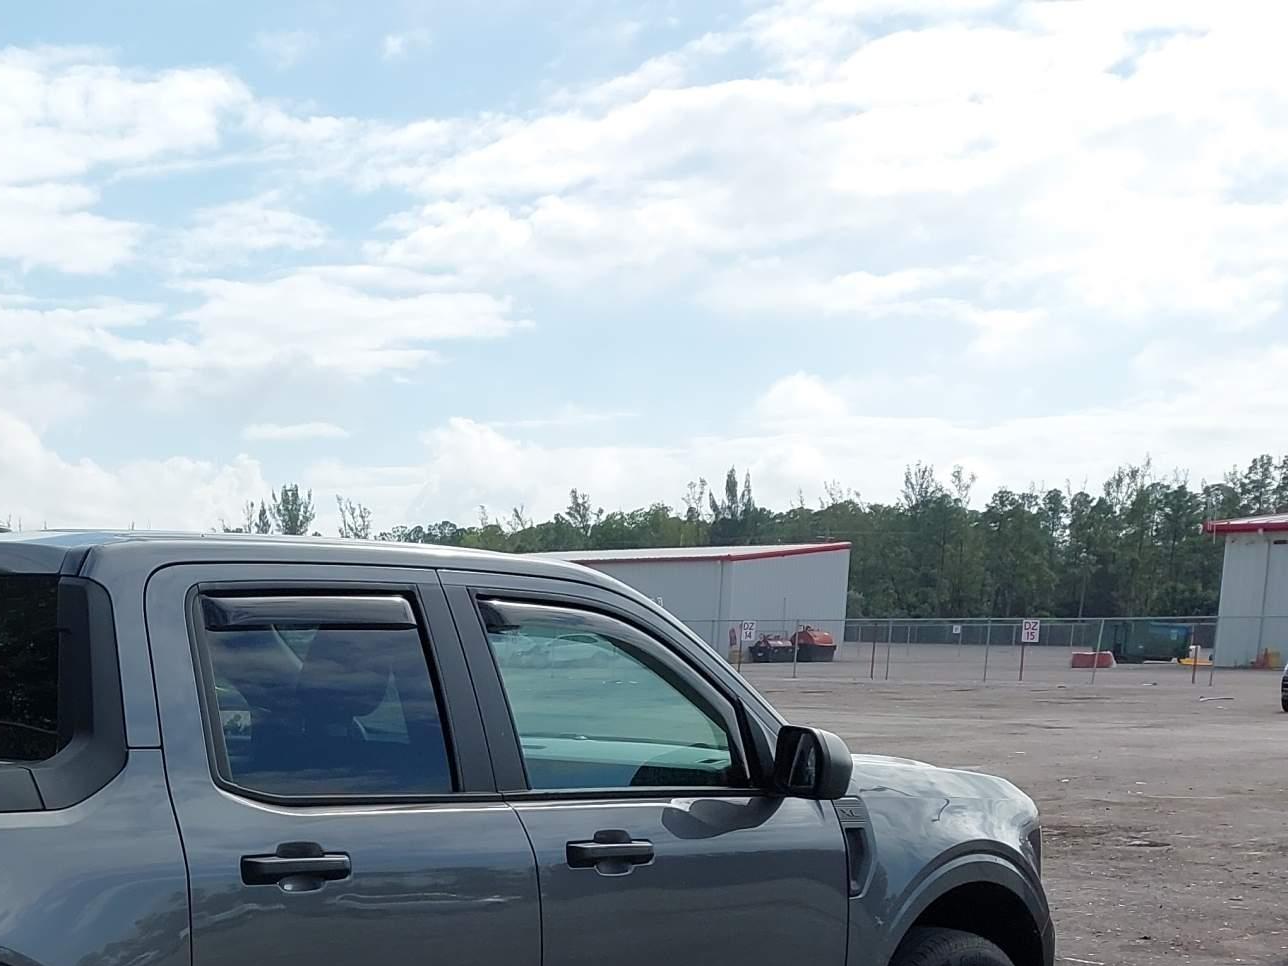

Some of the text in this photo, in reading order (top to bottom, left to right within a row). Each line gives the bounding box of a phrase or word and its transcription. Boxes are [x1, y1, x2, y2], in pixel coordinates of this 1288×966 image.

[743, 622, 755, 631] DZ
[1024, 621, 1039, 631] DZ
[744, 631, 752, 640] 14
[1026, 631, 1036, 641] 15
